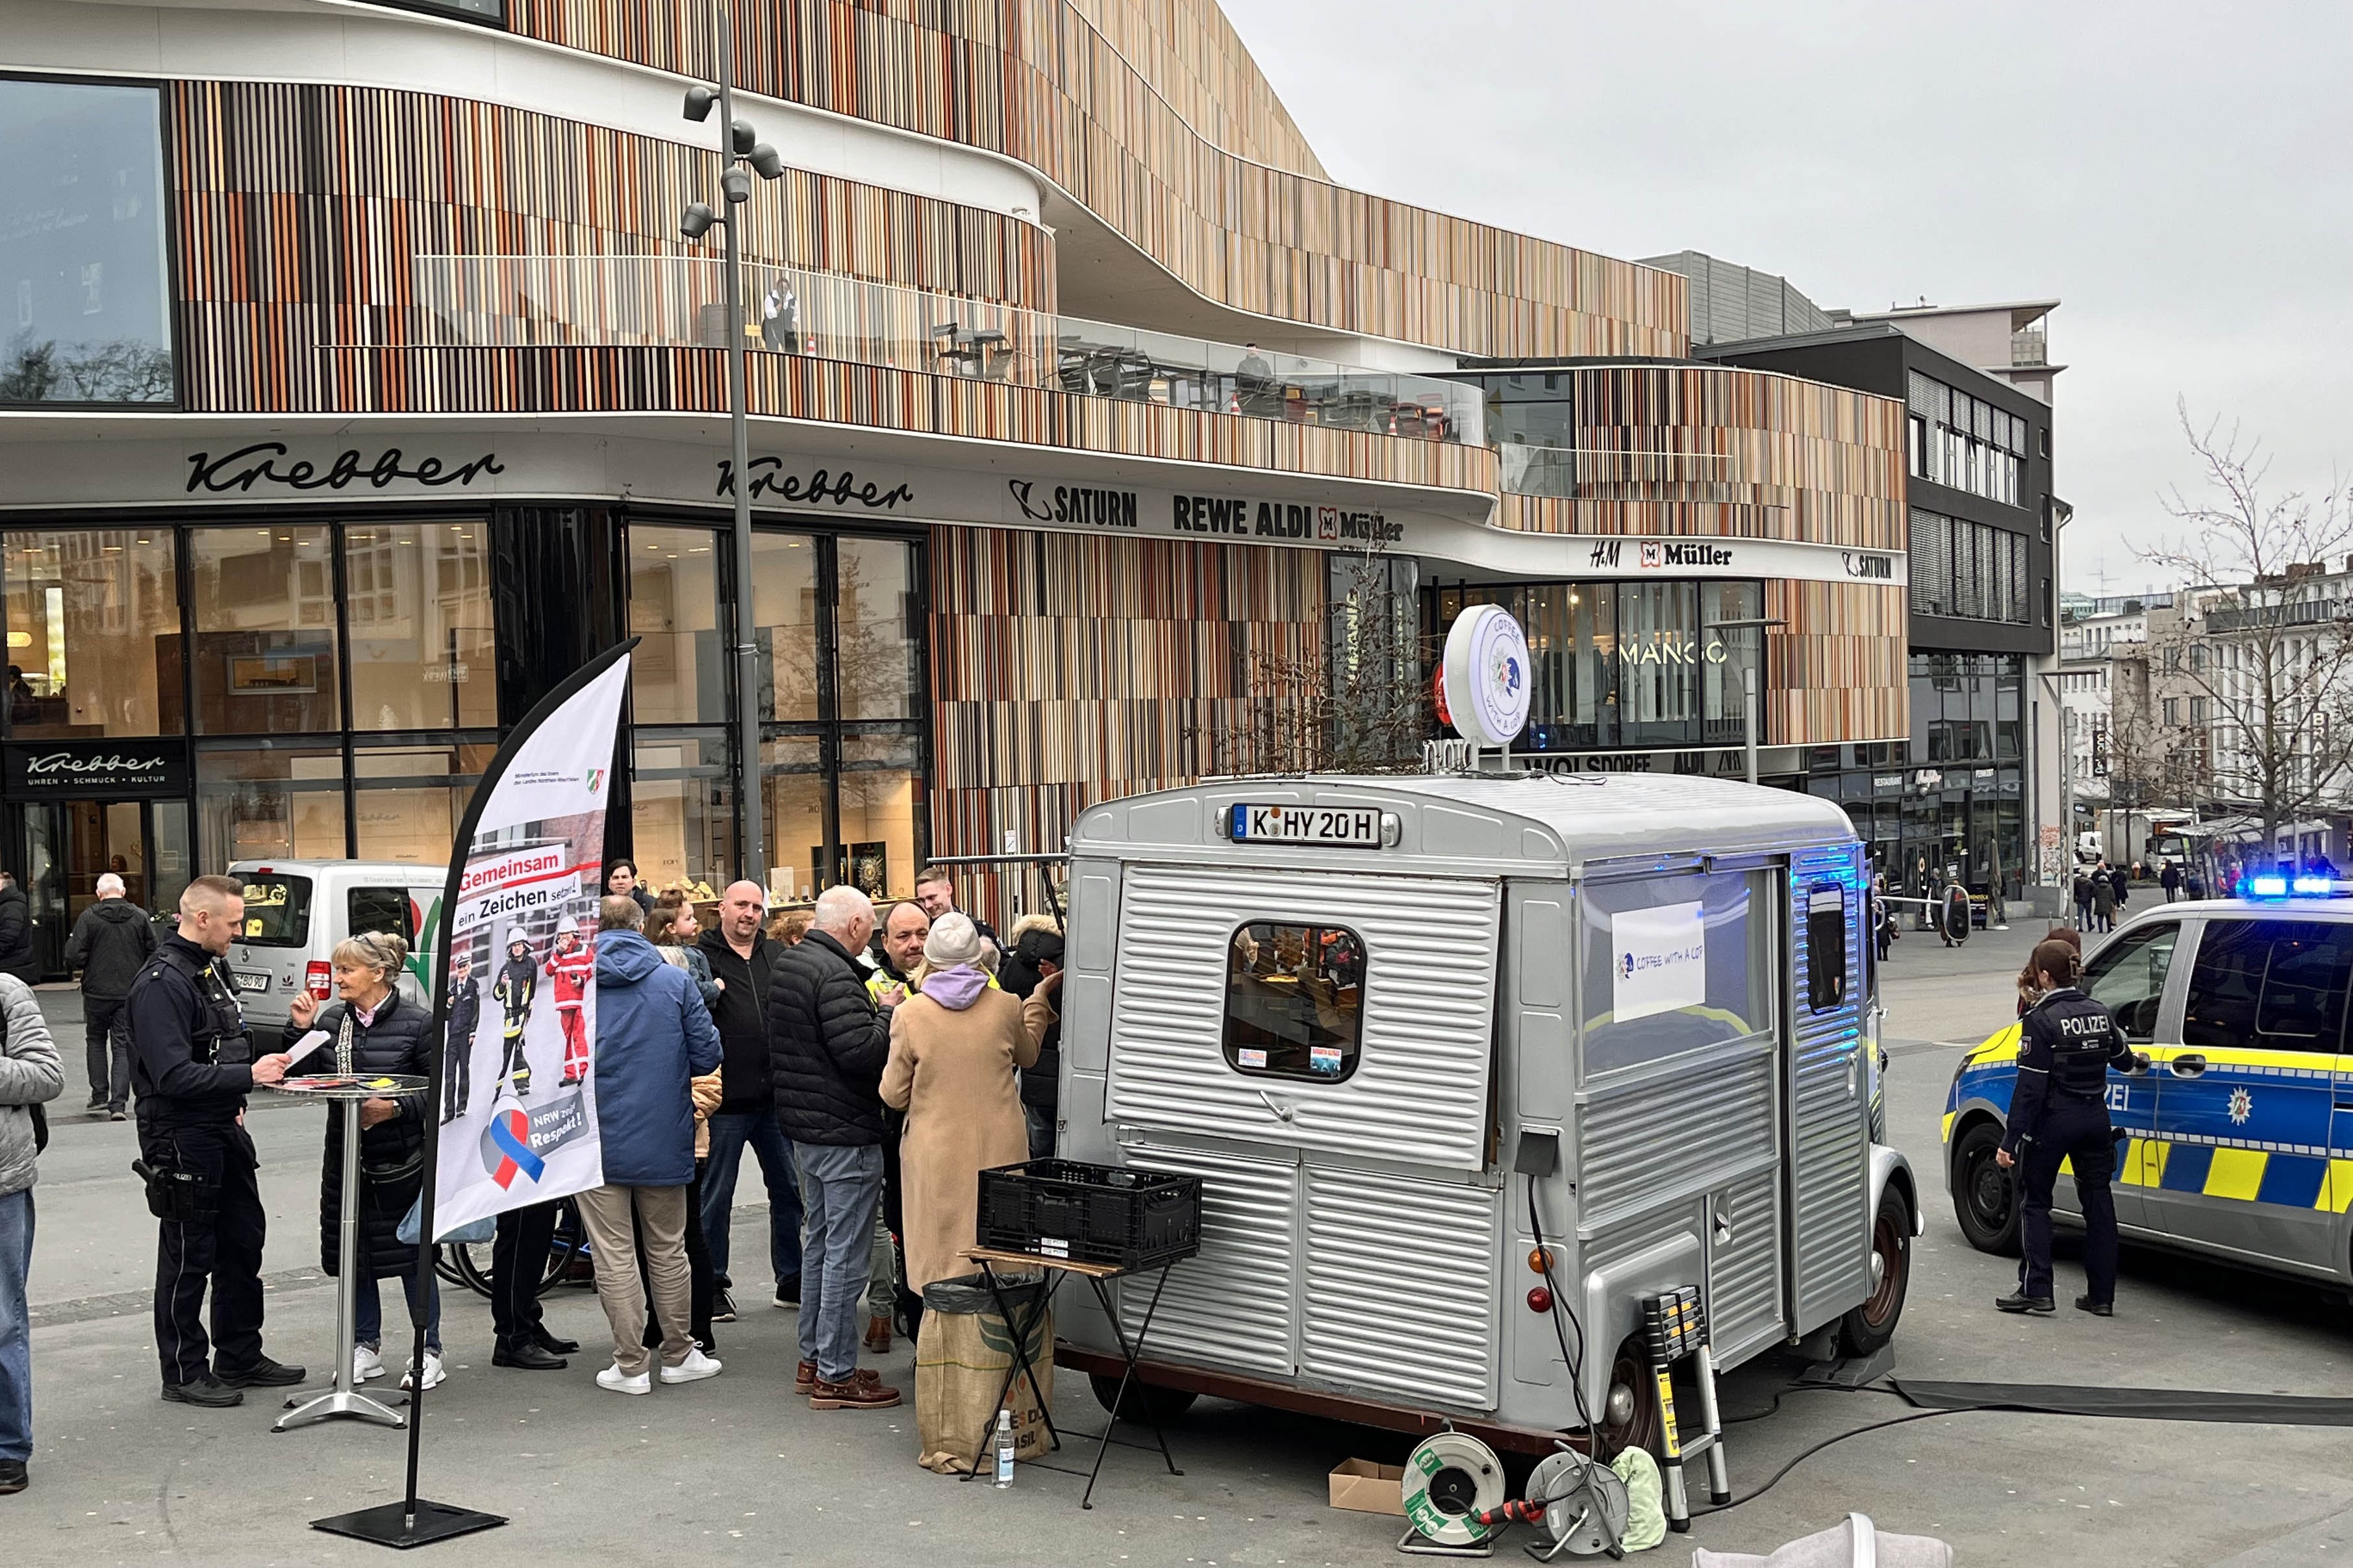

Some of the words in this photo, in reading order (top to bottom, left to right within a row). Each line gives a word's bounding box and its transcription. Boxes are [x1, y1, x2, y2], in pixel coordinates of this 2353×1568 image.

[186, 442, 505, 492] Krebber
[717, 456, 913, 509] Krebber
[1055, 486, 1137, 527] SATURN
[1173, 495, 1248, 534] REWE
[1255, 502, 1312, 538] ALDI
[1340, 512, 1403, 541] Müller
[1590, 540, 1621, 568] H&M
[1664, 543, 1733, 565] Müller
[1859, 554, 1891, 579] SATURN
[1494, 619, 1521, 645] COFFEE
[1504, 719, 1508, 731] A
[27, 753, 165, 773] Krebber
[1674, 751, 1705, 773] ALDI
[1253, 810, 1268, 836] K
[1284, 812, 1315, 836] HY
[460, 854, 559, 891] Gemeinsam
[459, 912, 475, 927] ein
[479, 890, 547, 919] Zeichen
[1637, 956, 1662, 969] COFFEE
[1665, 952, 1683, 965] WITH
[1685, 948, 1689, 961] A
[1691, 945, 1704, 960] COP
[2060, 1015, 2110, 1036] POLIZEI
[530, 1112, 582, 1149] Respekt!
[533, 1110, 559, 1128] NRW
